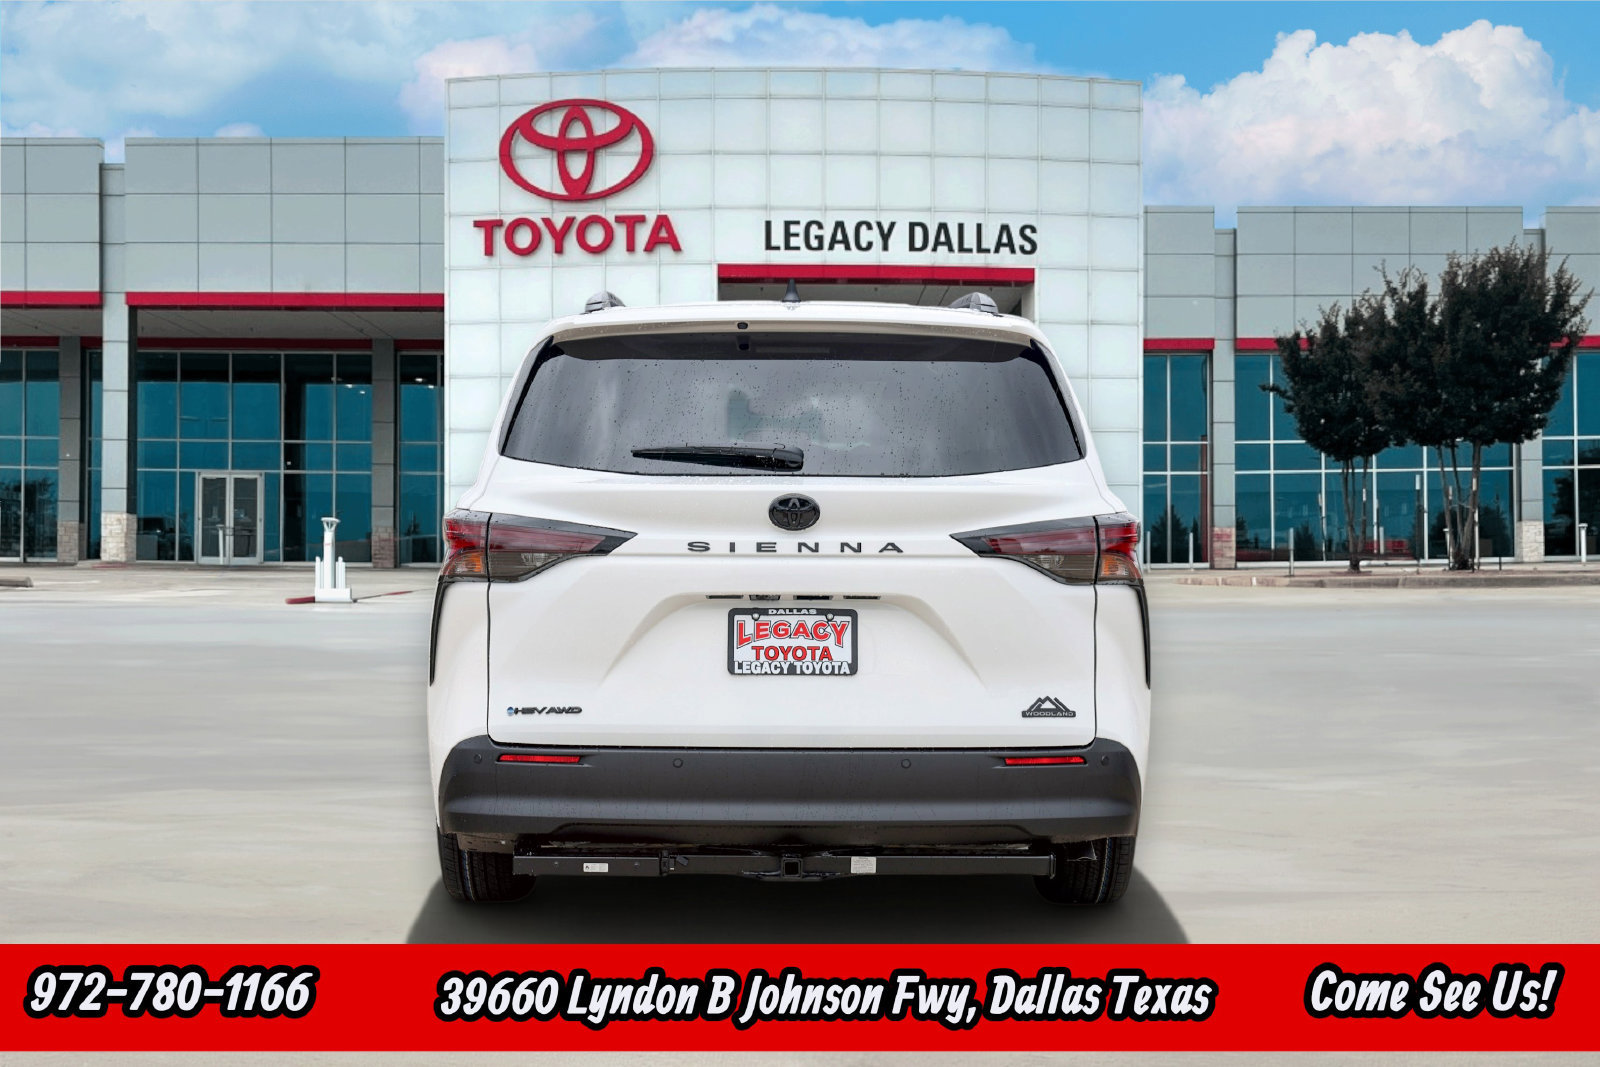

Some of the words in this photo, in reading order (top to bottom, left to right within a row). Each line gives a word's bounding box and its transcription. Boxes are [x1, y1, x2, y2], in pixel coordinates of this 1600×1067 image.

[474, 214, 682, 257] TOYOTA
[764, 220, 896, 253] LEGACY
[907, 221, 1038, 256] DALLAS
[687, 541, 904, 553] SIENNA
[736, 620, 849, 648] LEGACY
[751, 645, 833, 661] TOYOTA
[734, 661, 791, 675] LEGACY
[793, 661, 850, 675] TOYOTA
